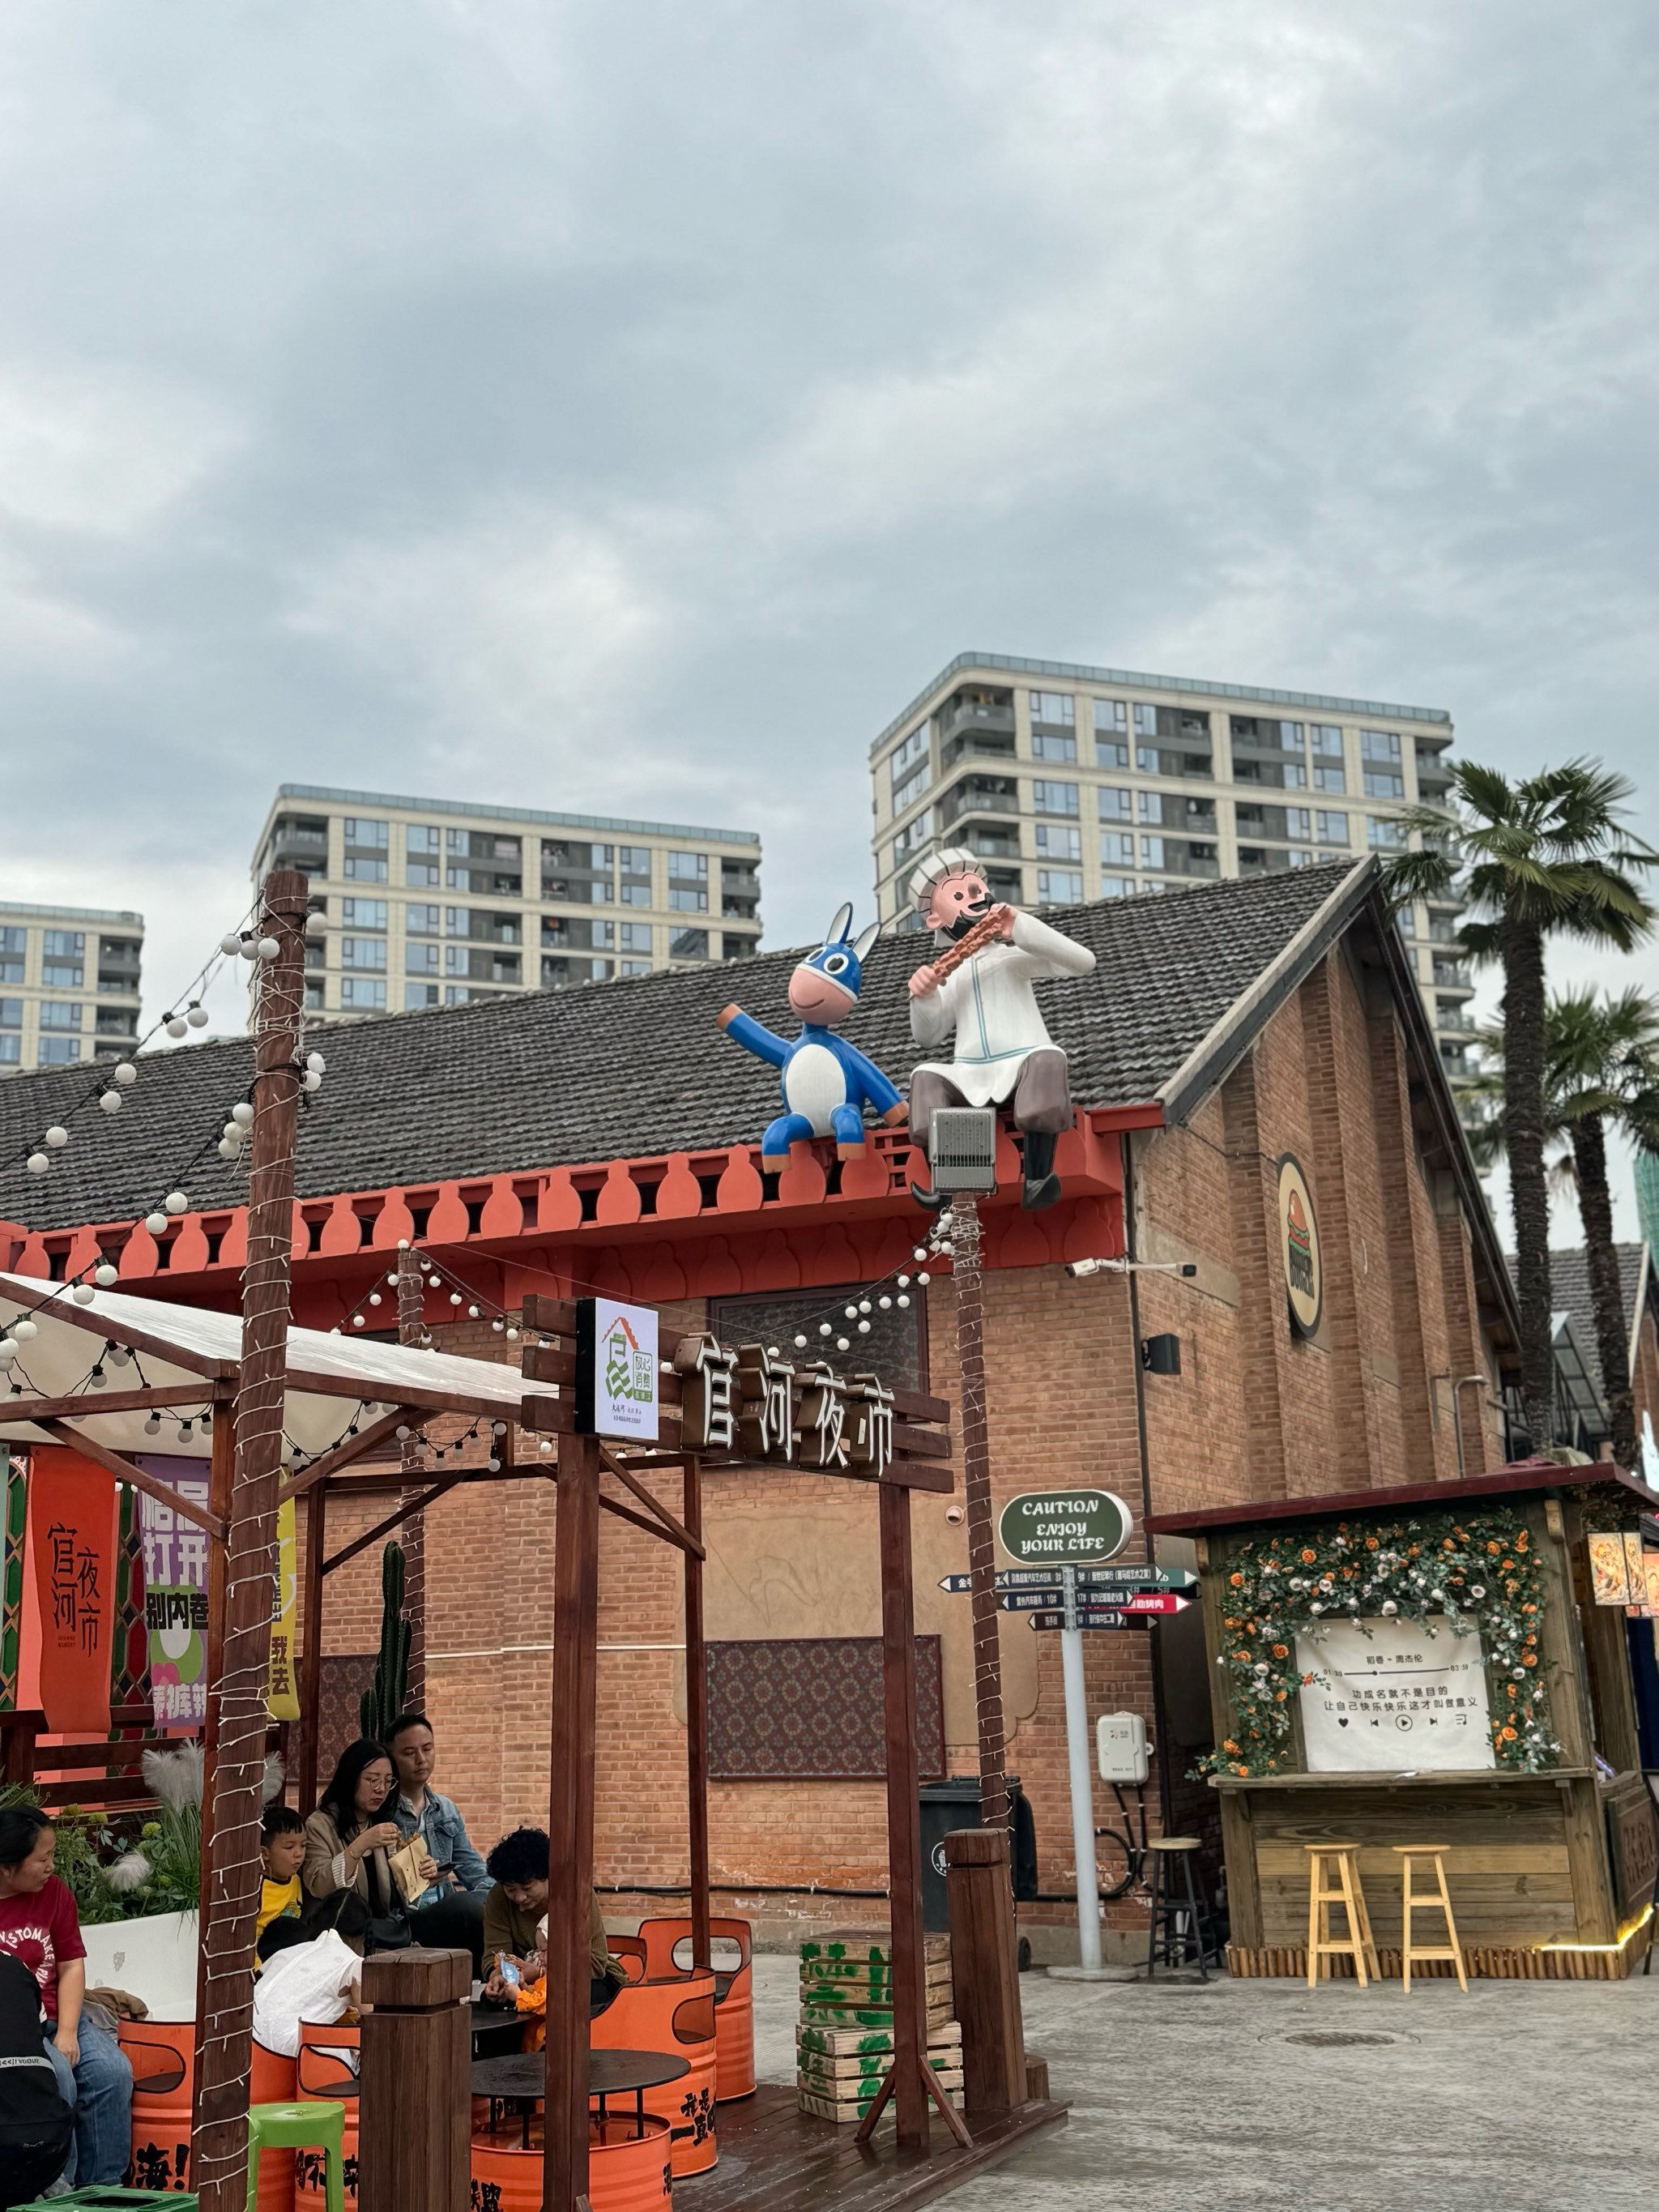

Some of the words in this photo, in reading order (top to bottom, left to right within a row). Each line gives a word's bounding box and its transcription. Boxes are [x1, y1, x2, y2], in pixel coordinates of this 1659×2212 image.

[696, 1334, 895, 1477] 官河夜市
[1022, 1500, 1098, 1515] CAUTION
[1037, 1522, 1086, 1536] ENJOY
[1021, 1539, 1064, 1554] YOUR
[1067, 1537, 1104, 1550] LIFE
[143, 1532, 209, 1586] 打开
[47, 1522, 79, 1632] 官河
[77, 1547, 100, 1658] 夜市
[147, 1593, 208, 1629] 别内卷
[1396, 1654, 1422, 1663] 周杰伦
[1352, 1686, 1448, 1699] 功成名就不是目的
[1324, 1697, 1478, 1711] 让自己快乐快乐这才叫做意义
